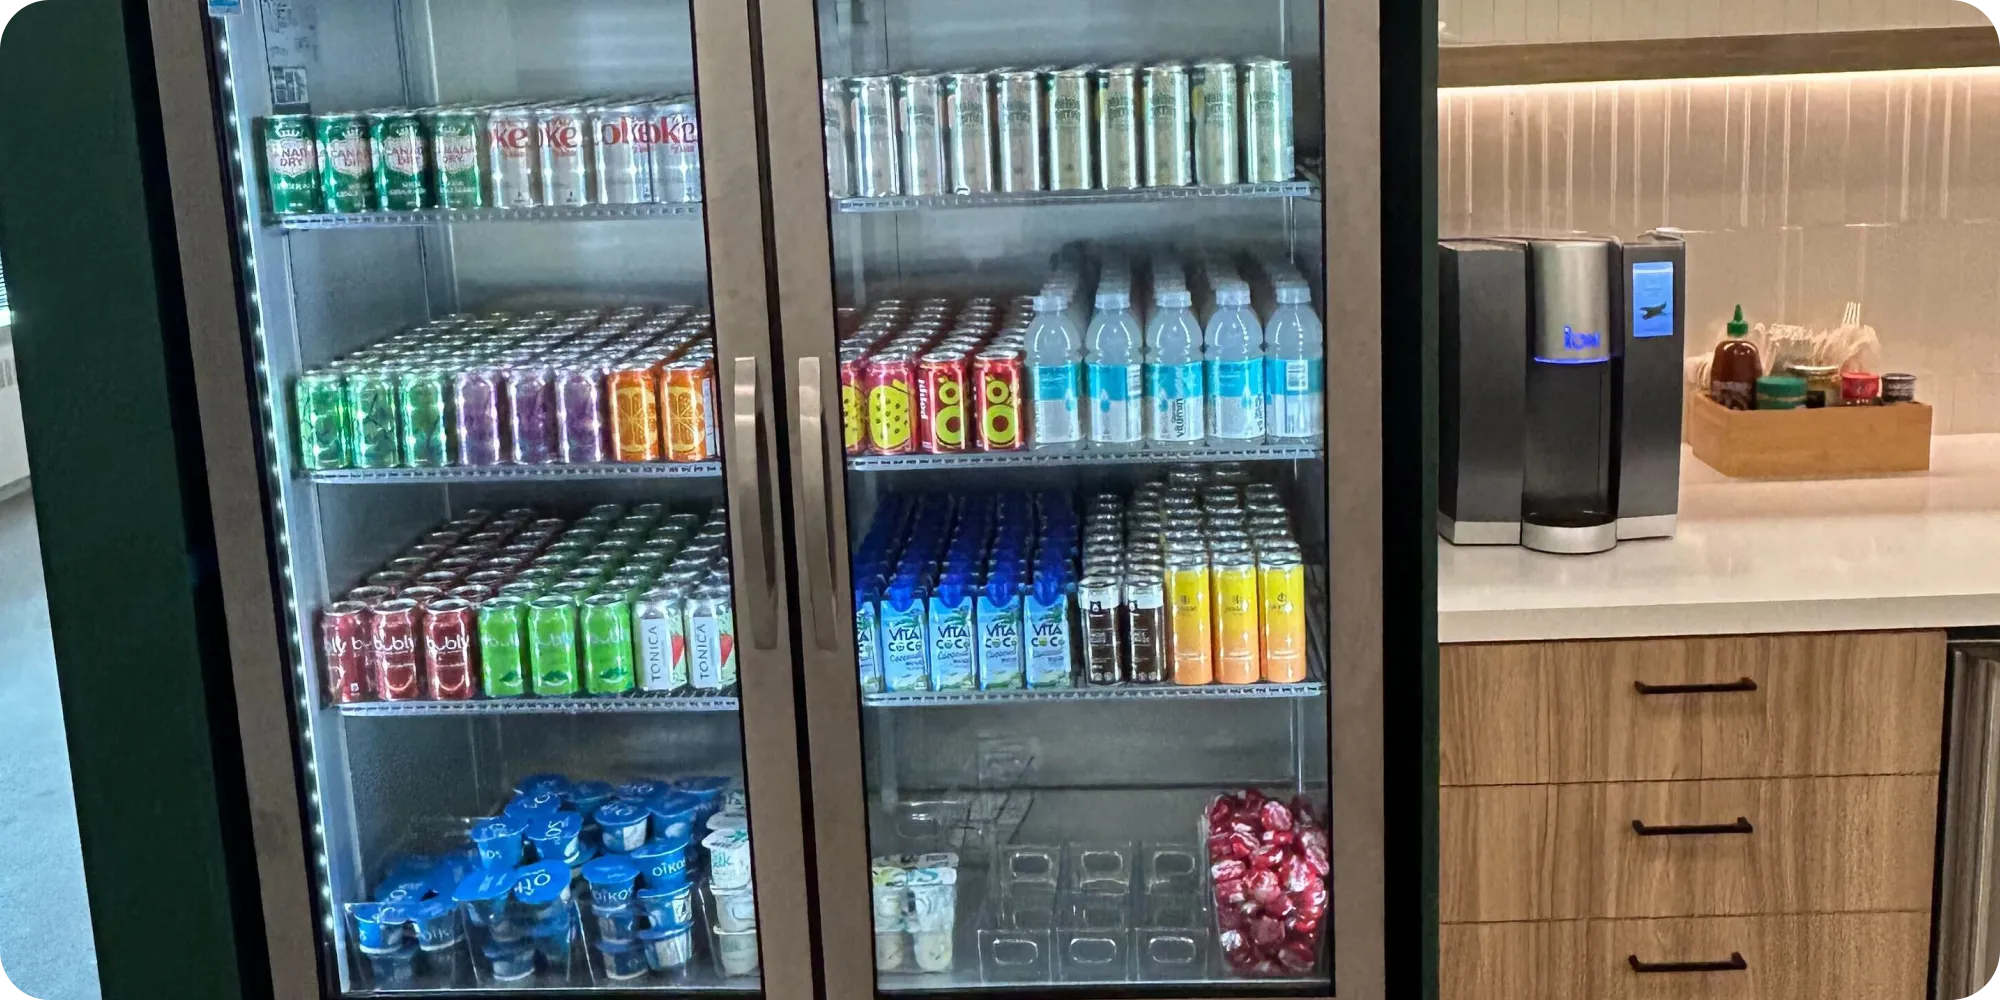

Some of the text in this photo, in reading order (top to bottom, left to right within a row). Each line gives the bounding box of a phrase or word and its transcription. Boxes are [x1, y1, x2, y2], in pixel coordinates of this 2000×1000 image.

[280, 157, 304, 168] DRY
[889, 628, 920, 641] VITA
[938, 624, 967, 638] VITA
[986, 622, 1016, 636] VITA
[1032, 623, 1063, 636] VITA
[648, 626, 661, 682] TONICA
[696, 623, 709, 680] TONICA
